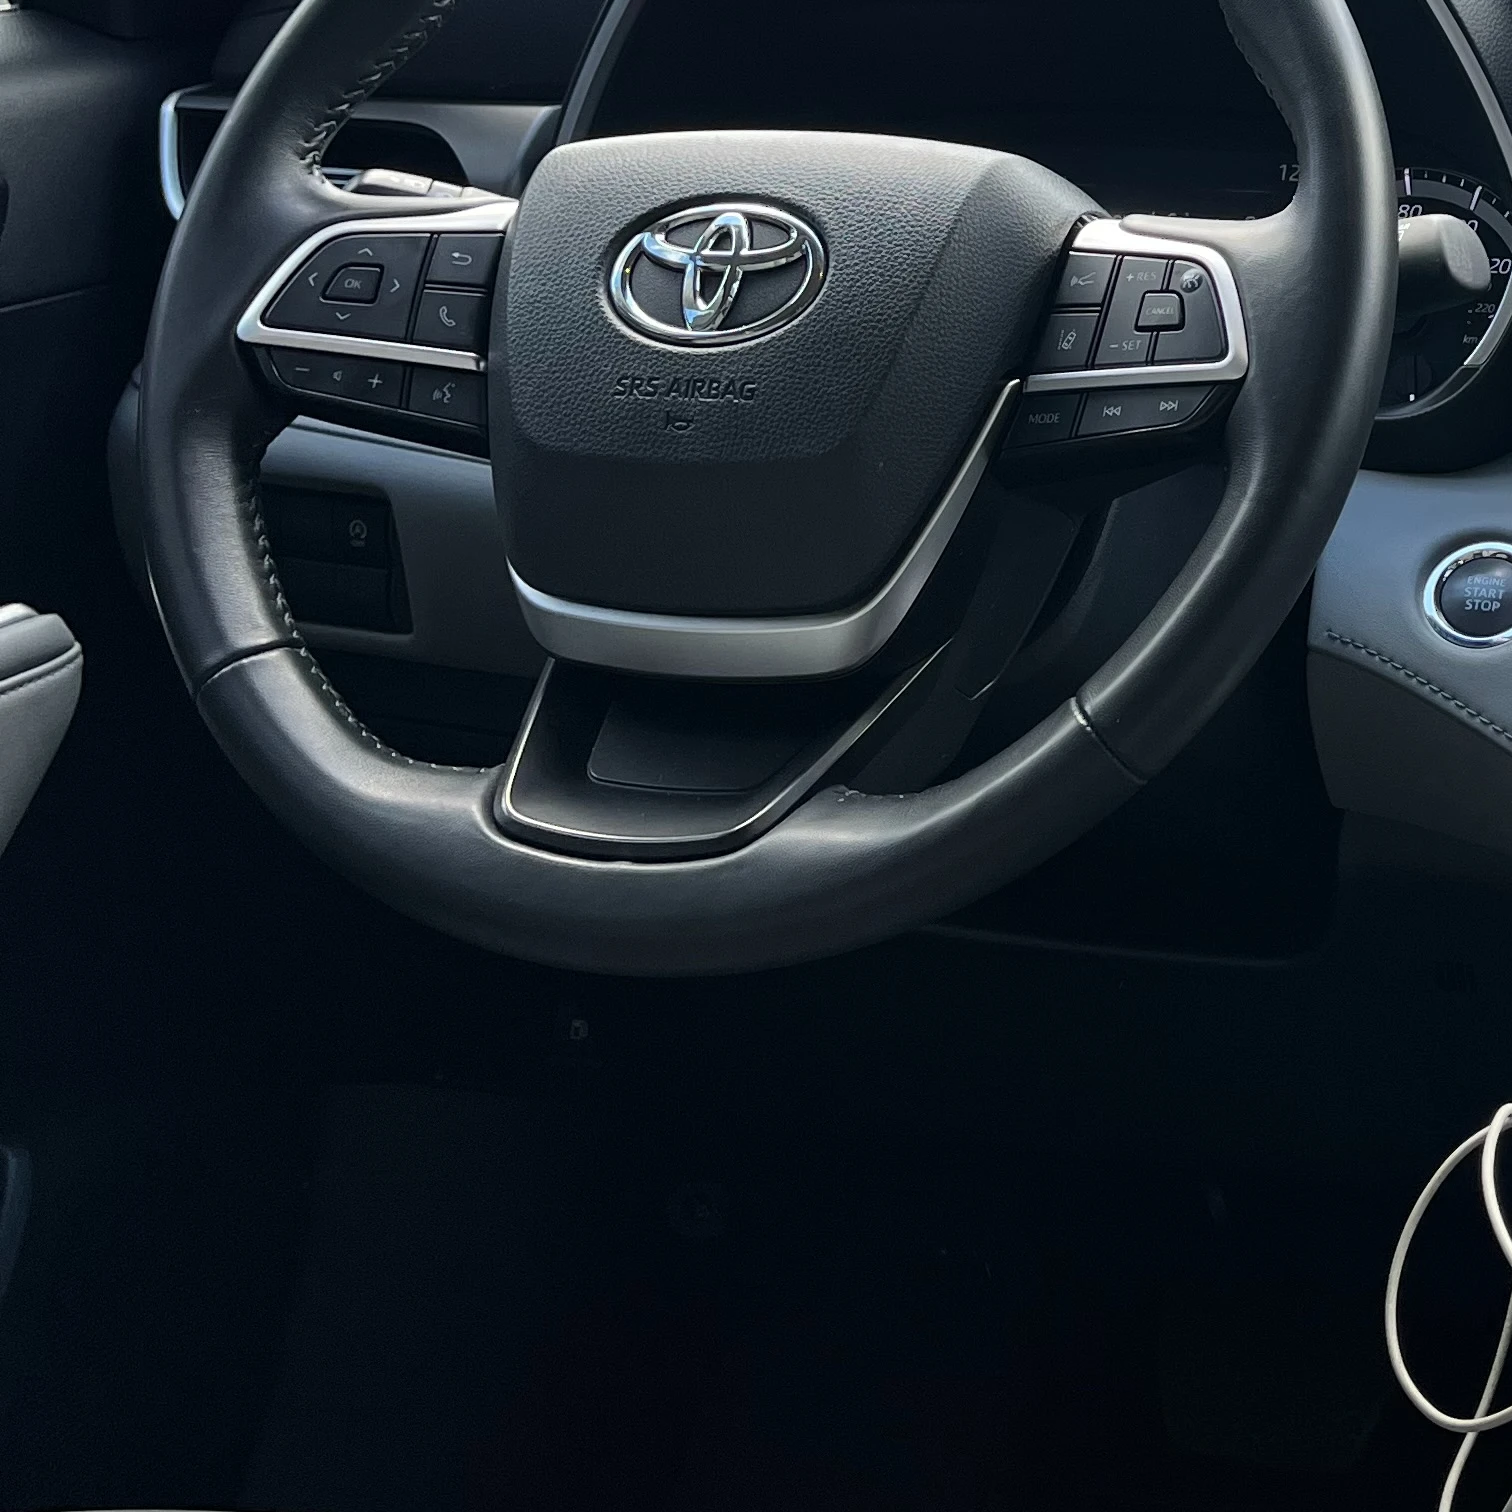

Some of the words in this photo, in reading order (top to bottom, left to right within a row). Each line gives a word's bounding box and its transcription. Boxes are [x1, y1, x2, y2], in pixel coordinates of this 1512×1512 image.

[344, 277, 362, 289] OK
[1136, 272, 1157, 282] RES
[1145, 306, 1175, 316] CANCEL
[1121, 339, 1142, 352] SET
[613, 375, 661, 400] SRS
[663, 377, 757, 403] AIRBAG
[1028, 410, 1061, 425] MODE
[1467, 575, 1508, 588] ENGINE
[1464, 586, 1506, 600] START
[1464, 598, 1501, 613] STOP
